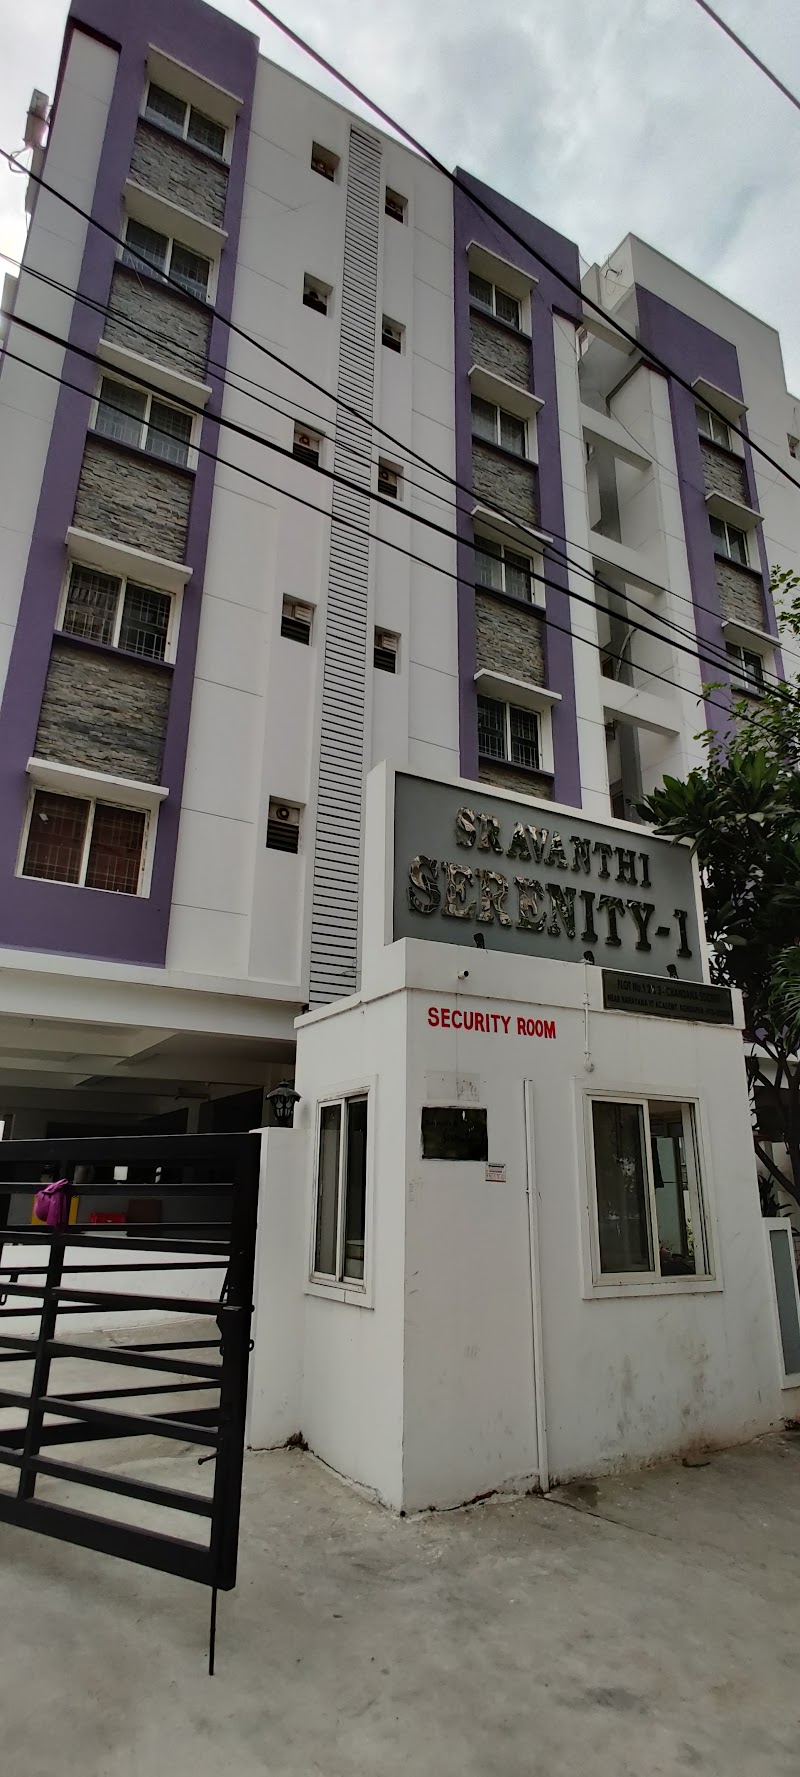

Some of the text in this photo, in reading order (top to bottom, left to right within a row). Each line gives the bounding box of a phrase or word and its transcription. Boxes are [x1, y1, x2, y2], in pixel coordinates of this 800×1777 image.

[456, 807, 651, 887] SRAVANTHI
[408, 855, 692, 957] SERENITY-I
[427, 1007, 557, 1040] SECURITY ROOM
